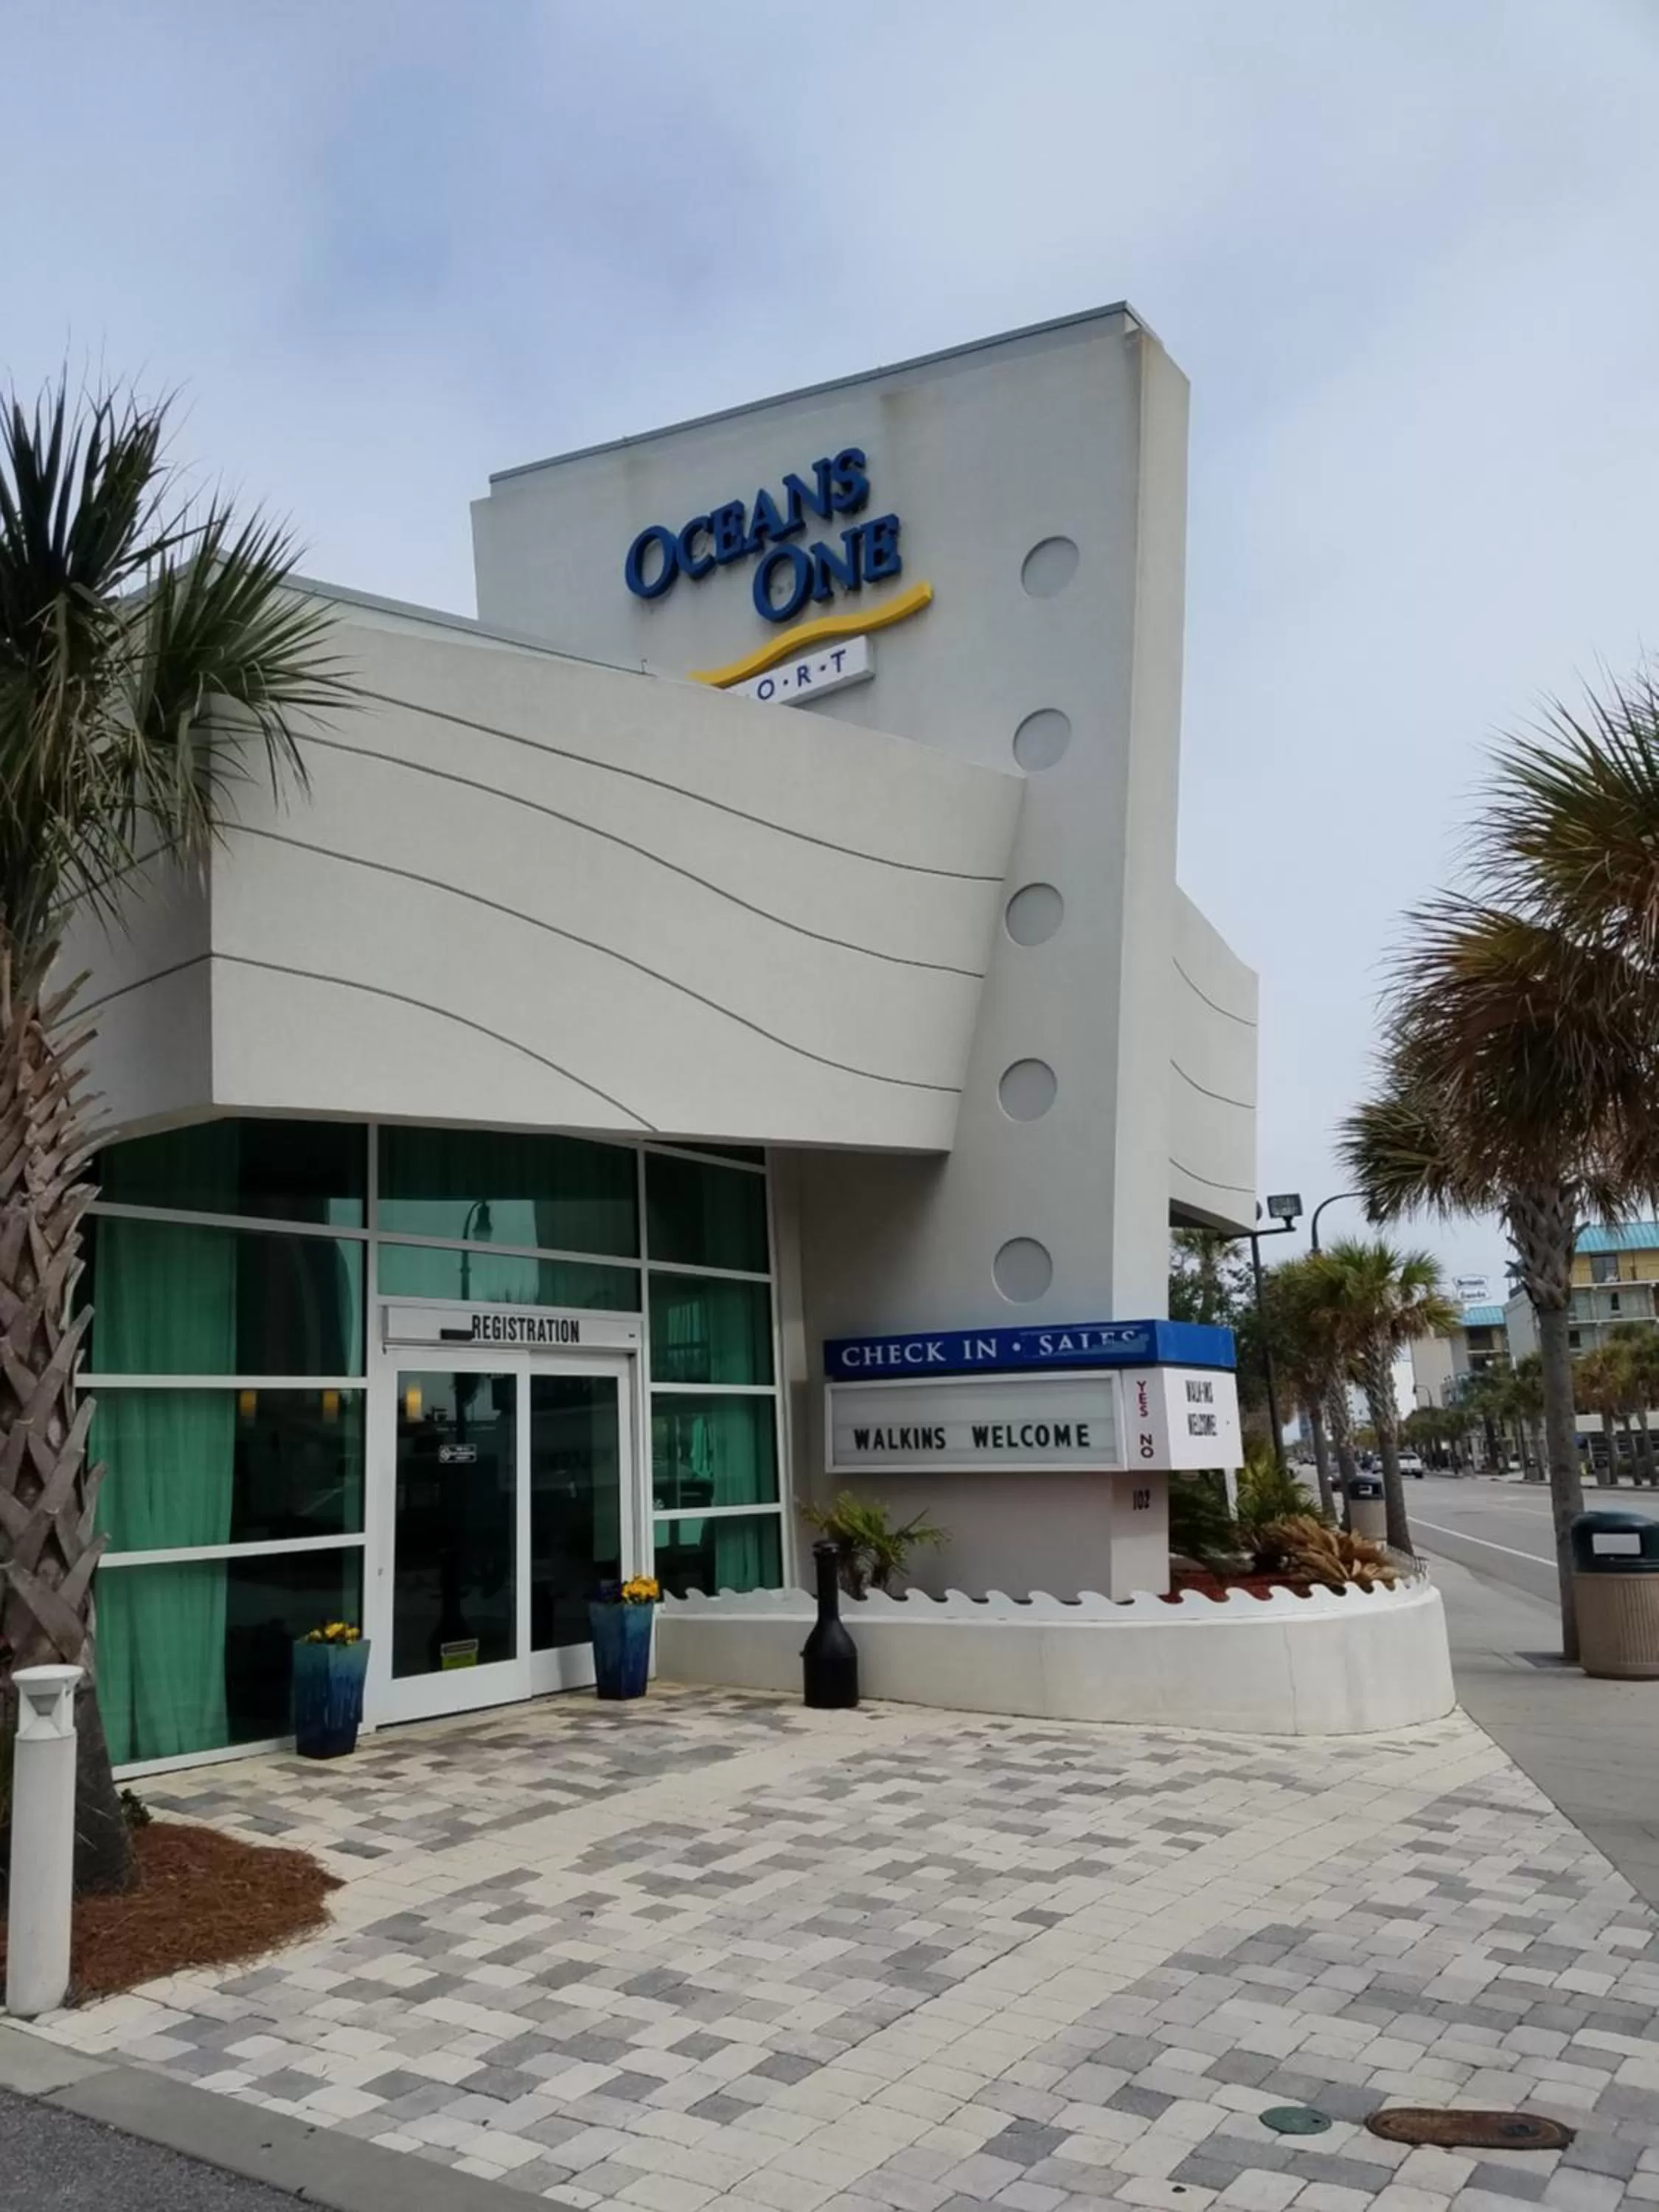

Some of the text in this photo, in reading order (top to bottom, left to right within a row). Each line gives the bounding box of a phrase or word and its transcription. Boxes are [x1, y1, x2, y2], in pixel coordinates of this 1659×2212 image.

[625, 448, 869, 599] OCEANS
[753, 514, 902, 622] ONE
[472, 1315, 580, 1343] REGISTRATION
[841, 1341, 946, 1367] CHECK
[964, 1338, 998, 1360] IN
[1136, 1380, 1149, 1418] YES
[854, 1424, 1090, 1450] WALKINS WELCOME
[1140, 1434, 1154, 1458] NO
